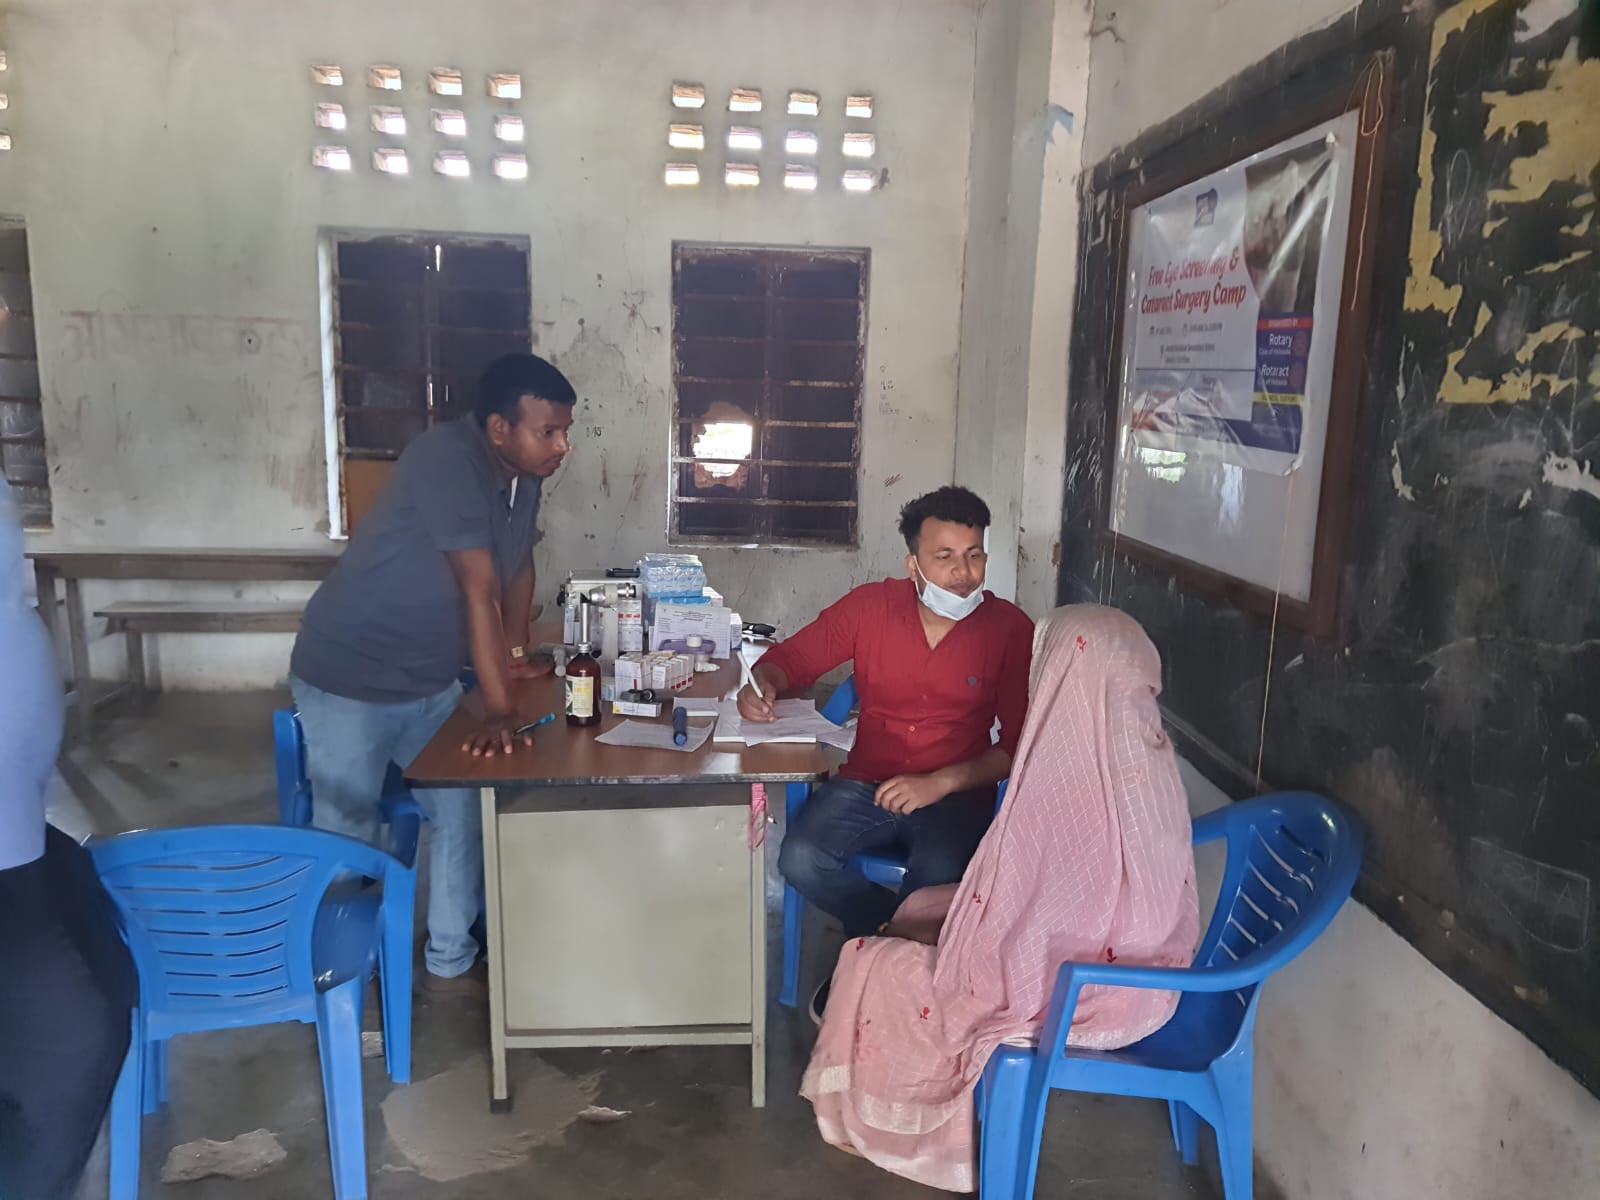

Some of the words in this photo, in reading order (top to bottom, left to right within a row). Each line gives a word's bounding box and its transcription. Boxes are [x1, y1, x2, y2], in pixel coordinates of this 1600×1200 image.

[1229, 246, 1239, 271] &
[1174, 287, 1211, 315] Surgery
[1213, 281, 1246, 310] Camp
[1268, 332, 1294, 348] Rotary
[1261, 363, 1290, 378] Rotaract
